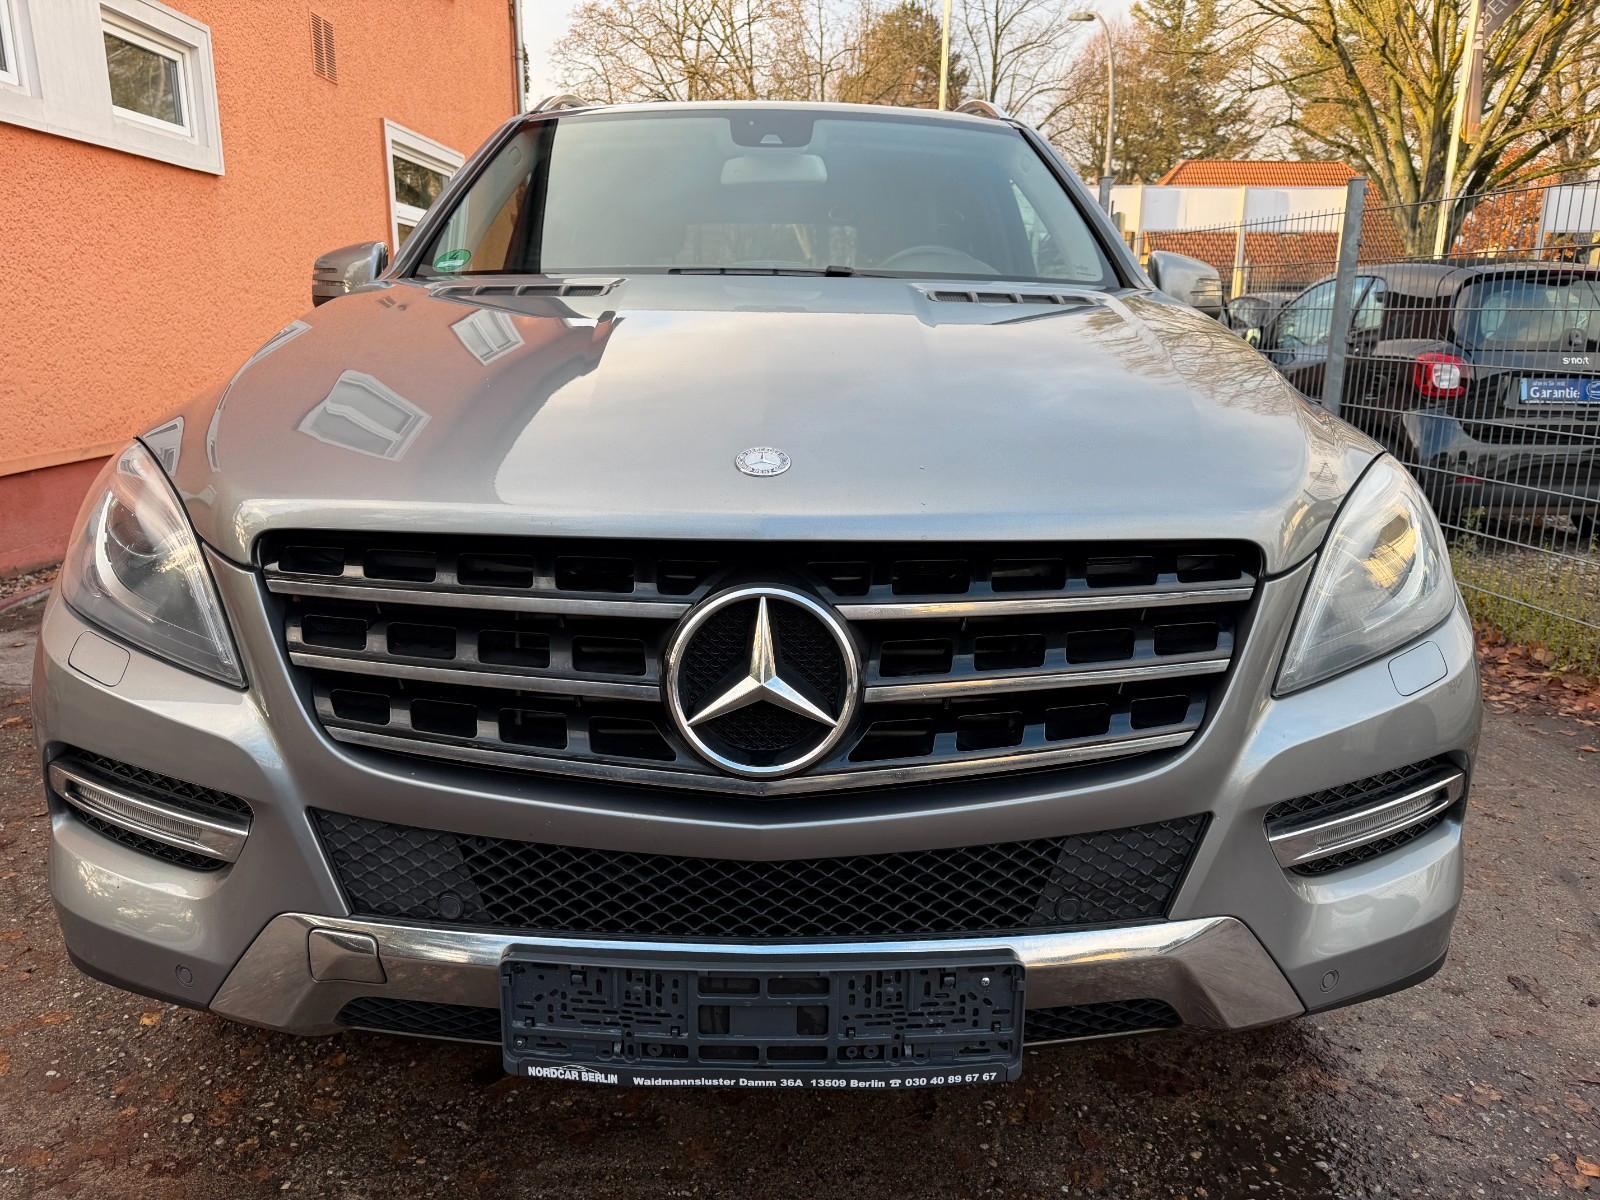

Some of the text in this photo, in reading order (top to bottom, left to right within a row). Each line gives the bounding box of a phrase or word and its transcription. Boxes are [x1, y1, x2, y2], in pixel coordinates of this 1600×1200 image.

[1530, 386, 1580, 398] Garantie
[528, 1066, 618, 1084] NORDCAR BERLIN
[632, 1072, 997, 1088] Waldmannsluster Damm 36A 13509 Berlin 030 40 89 67 67
